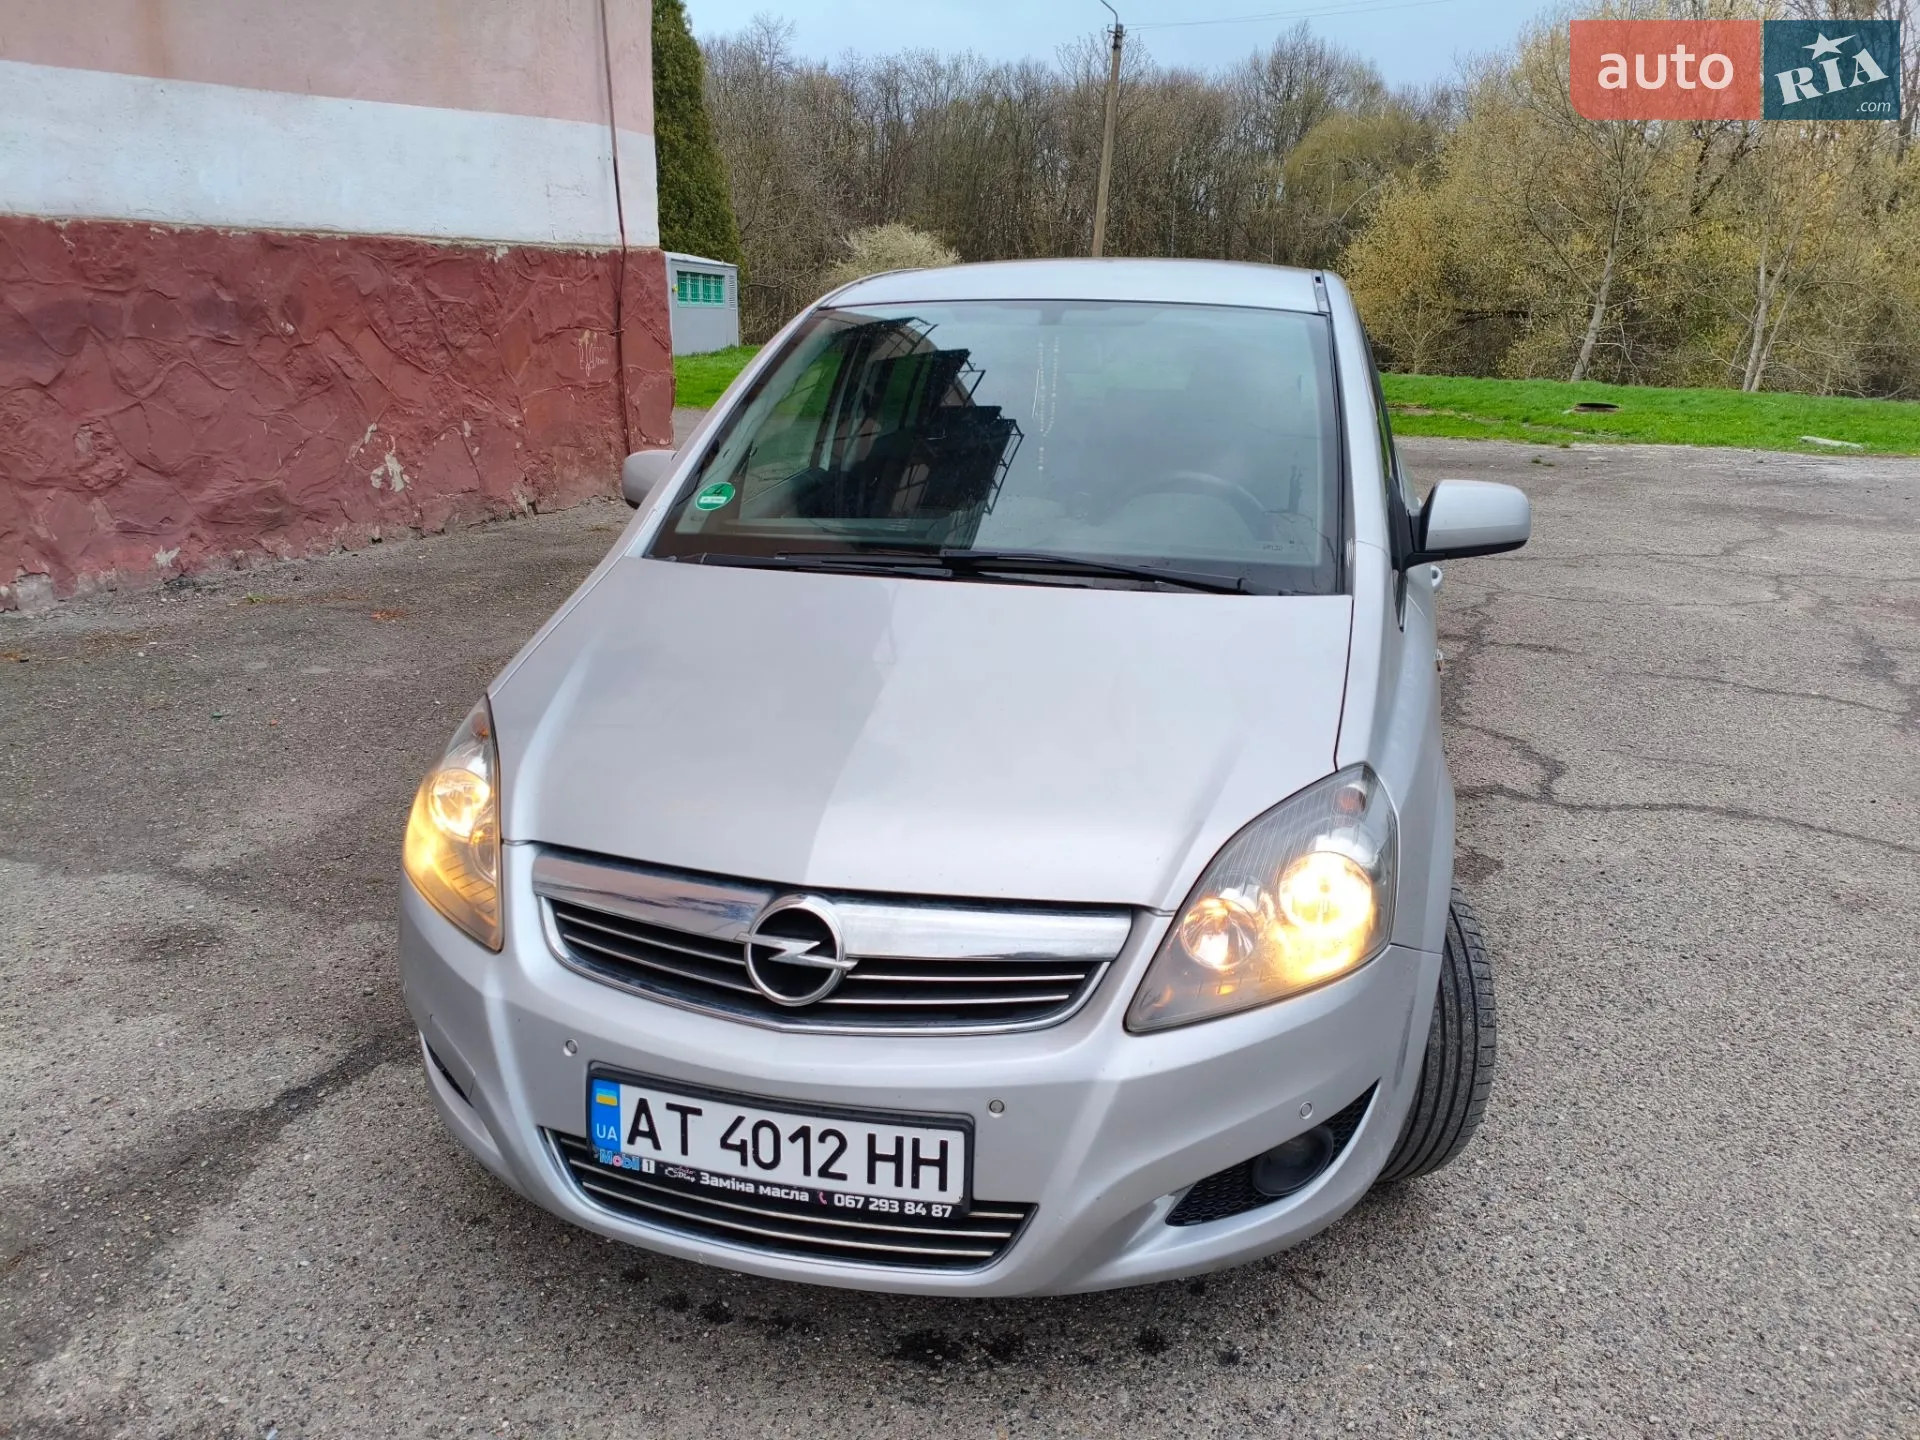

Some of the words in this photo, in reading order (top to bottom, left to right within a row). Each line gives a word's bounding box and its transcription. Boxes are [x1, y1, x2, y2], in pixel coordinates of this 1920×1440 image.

[596, 1123, 618, 1142] UA
[627, 1097, 703, 1156] AT
[719, 1115, 848, 1181] 4012
[867, 1132, 948, 1192] HH
[599, 1148, 640, 1171] Mobil
[642, 1158, 656, 1174] 1
[700, 1171, 755, 1193] Заміна
[759, 1184, 810, 1202] масла
[833, 1193, 865, 1209] 067
[868, 1197, 900, 1213] 293
[904, 1201, 927, 1216] 84
[931, 1204, 953, 1218] 87
